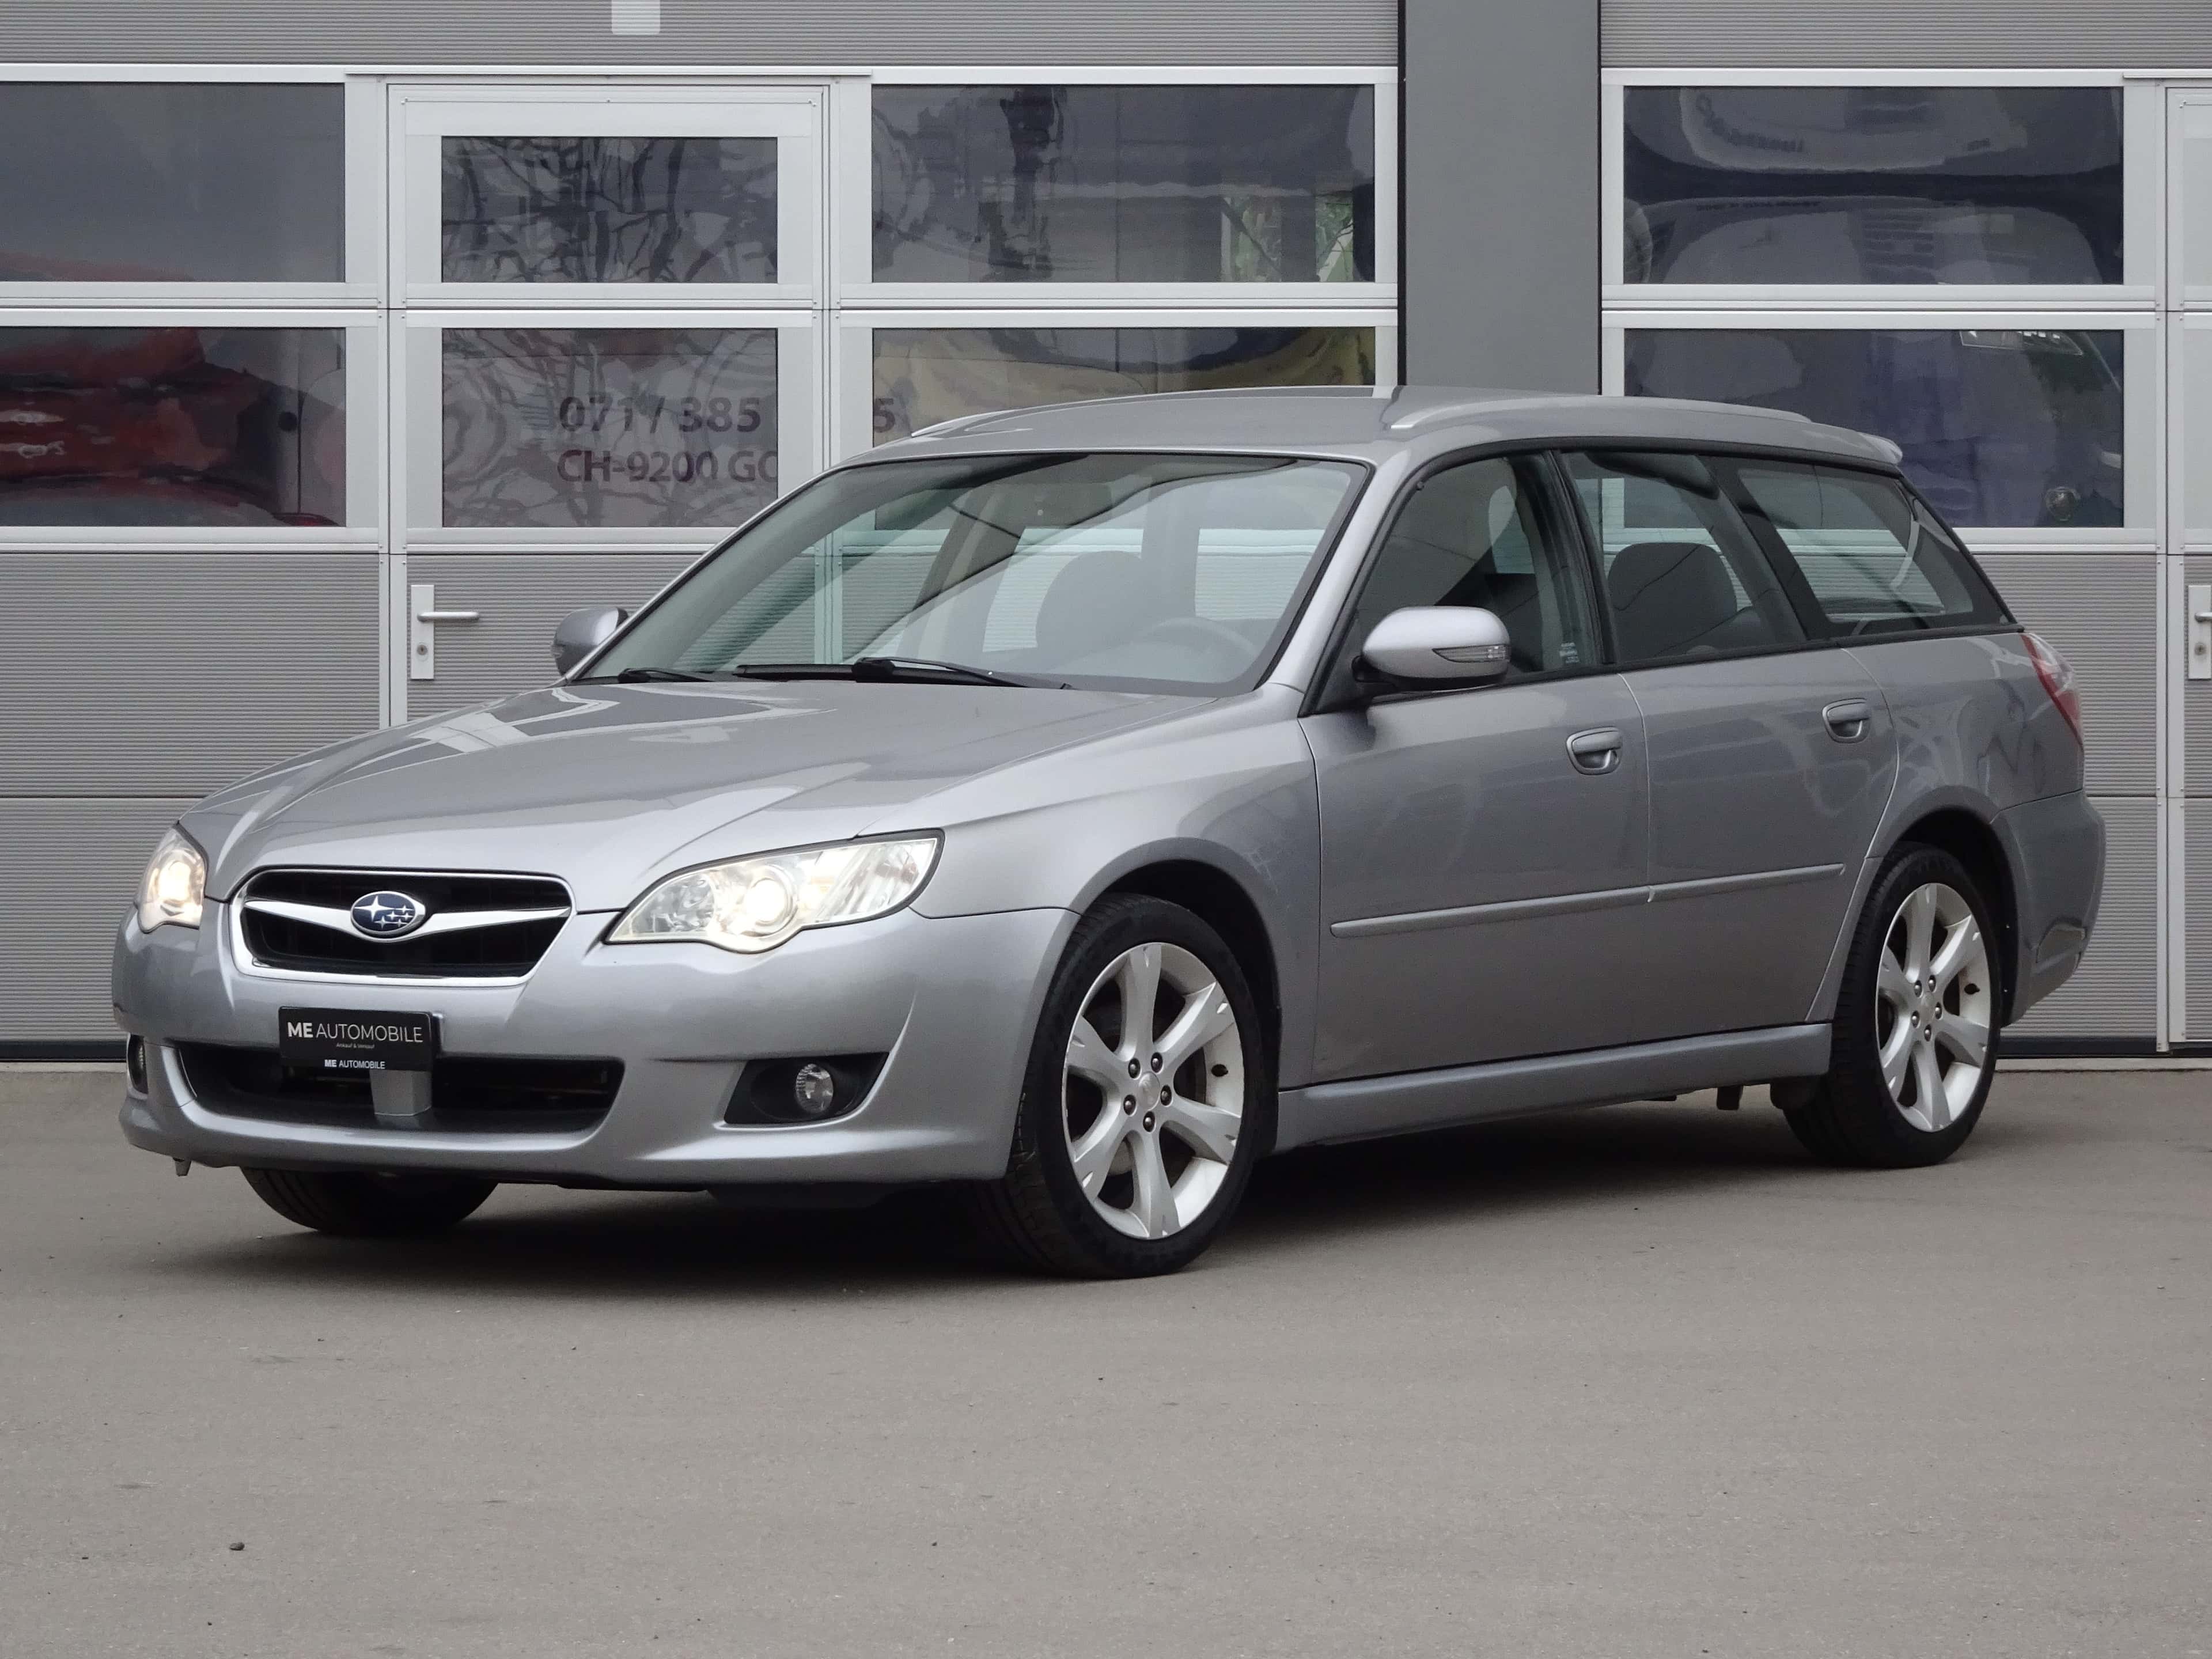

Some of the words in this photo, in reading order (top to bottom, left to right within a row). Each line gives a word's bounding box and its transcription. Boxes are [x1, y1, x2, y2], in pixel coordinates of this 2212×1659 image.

[559, 396, 633, 432] 071
[679, 396, 761, 432] 385
[557, 449, 718, 482] CH-9200
[288, 1022, 313, 1038] ME
[317, 1023, 423, 1043] AUTOMOBILE
[339, 1060, 385, 1069] AUTOMOBILE
